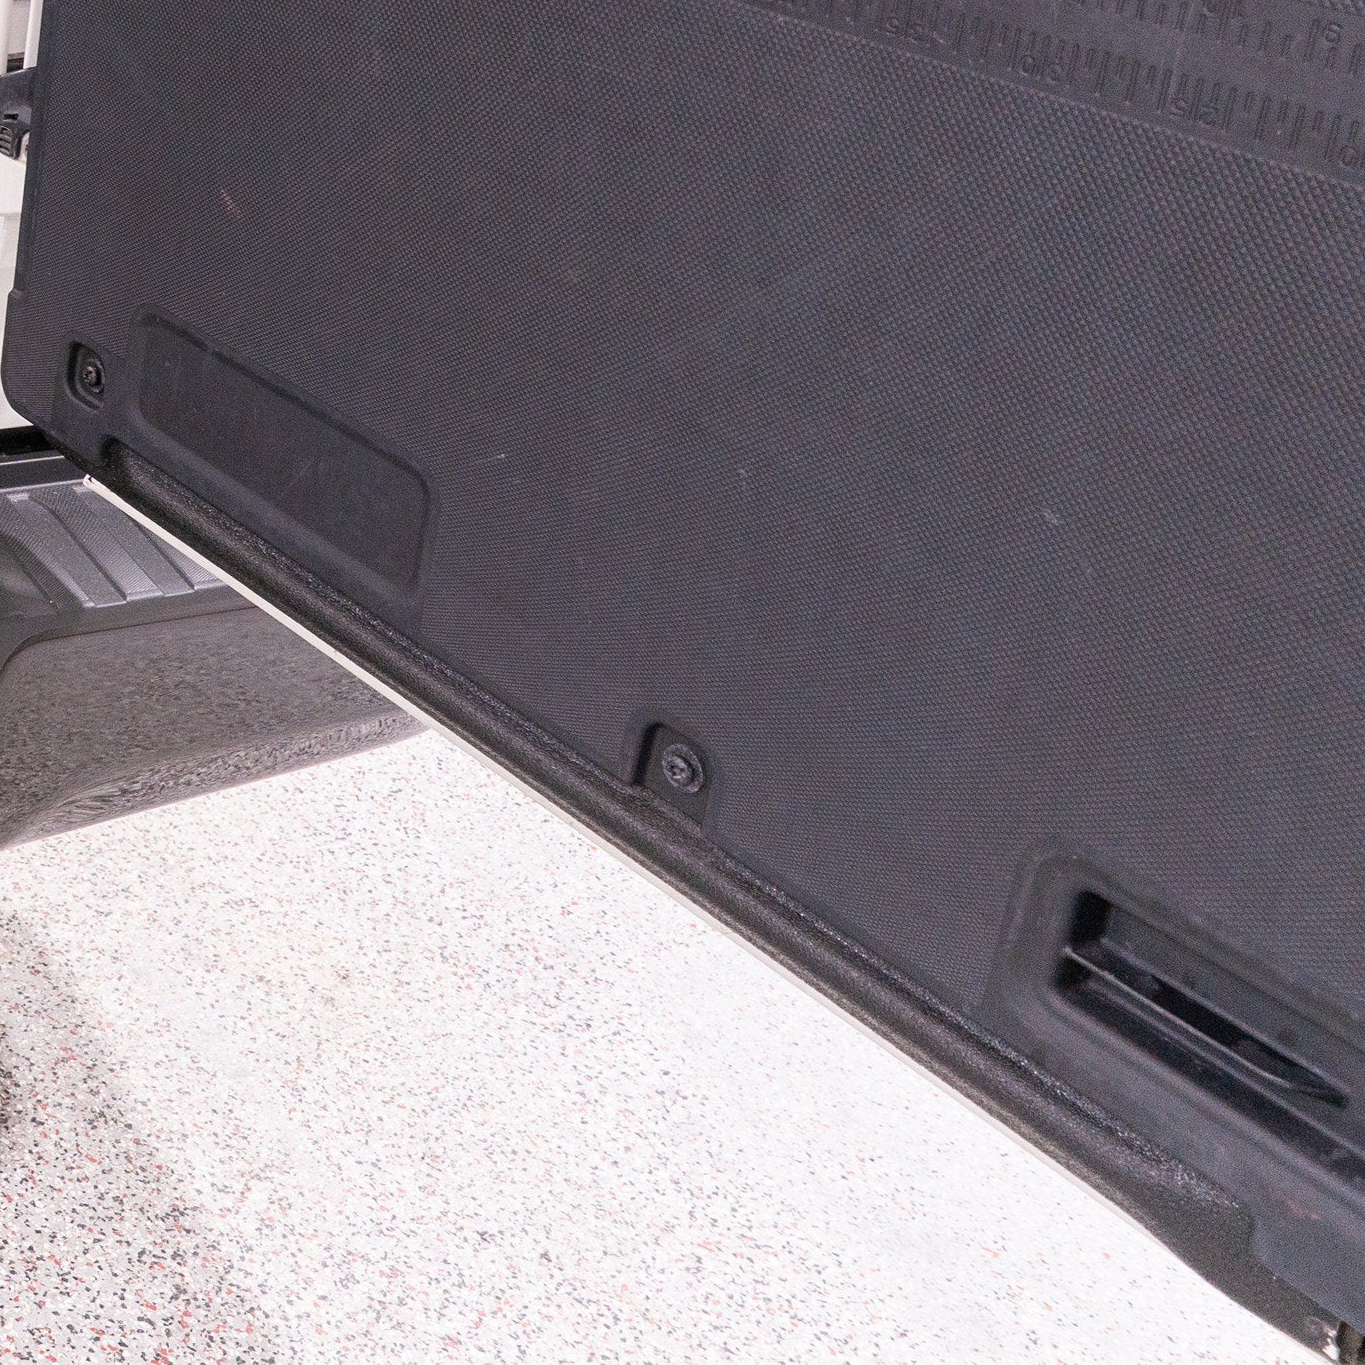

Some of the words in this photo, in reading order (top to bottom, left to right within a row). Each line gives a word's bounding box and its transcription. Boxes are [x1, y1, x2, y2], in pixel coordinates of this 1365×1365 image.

[886, 16, 924, 45] 35
[1019, 54, 1062, 86] 30
[1170, 97, 1217, 127] 25
